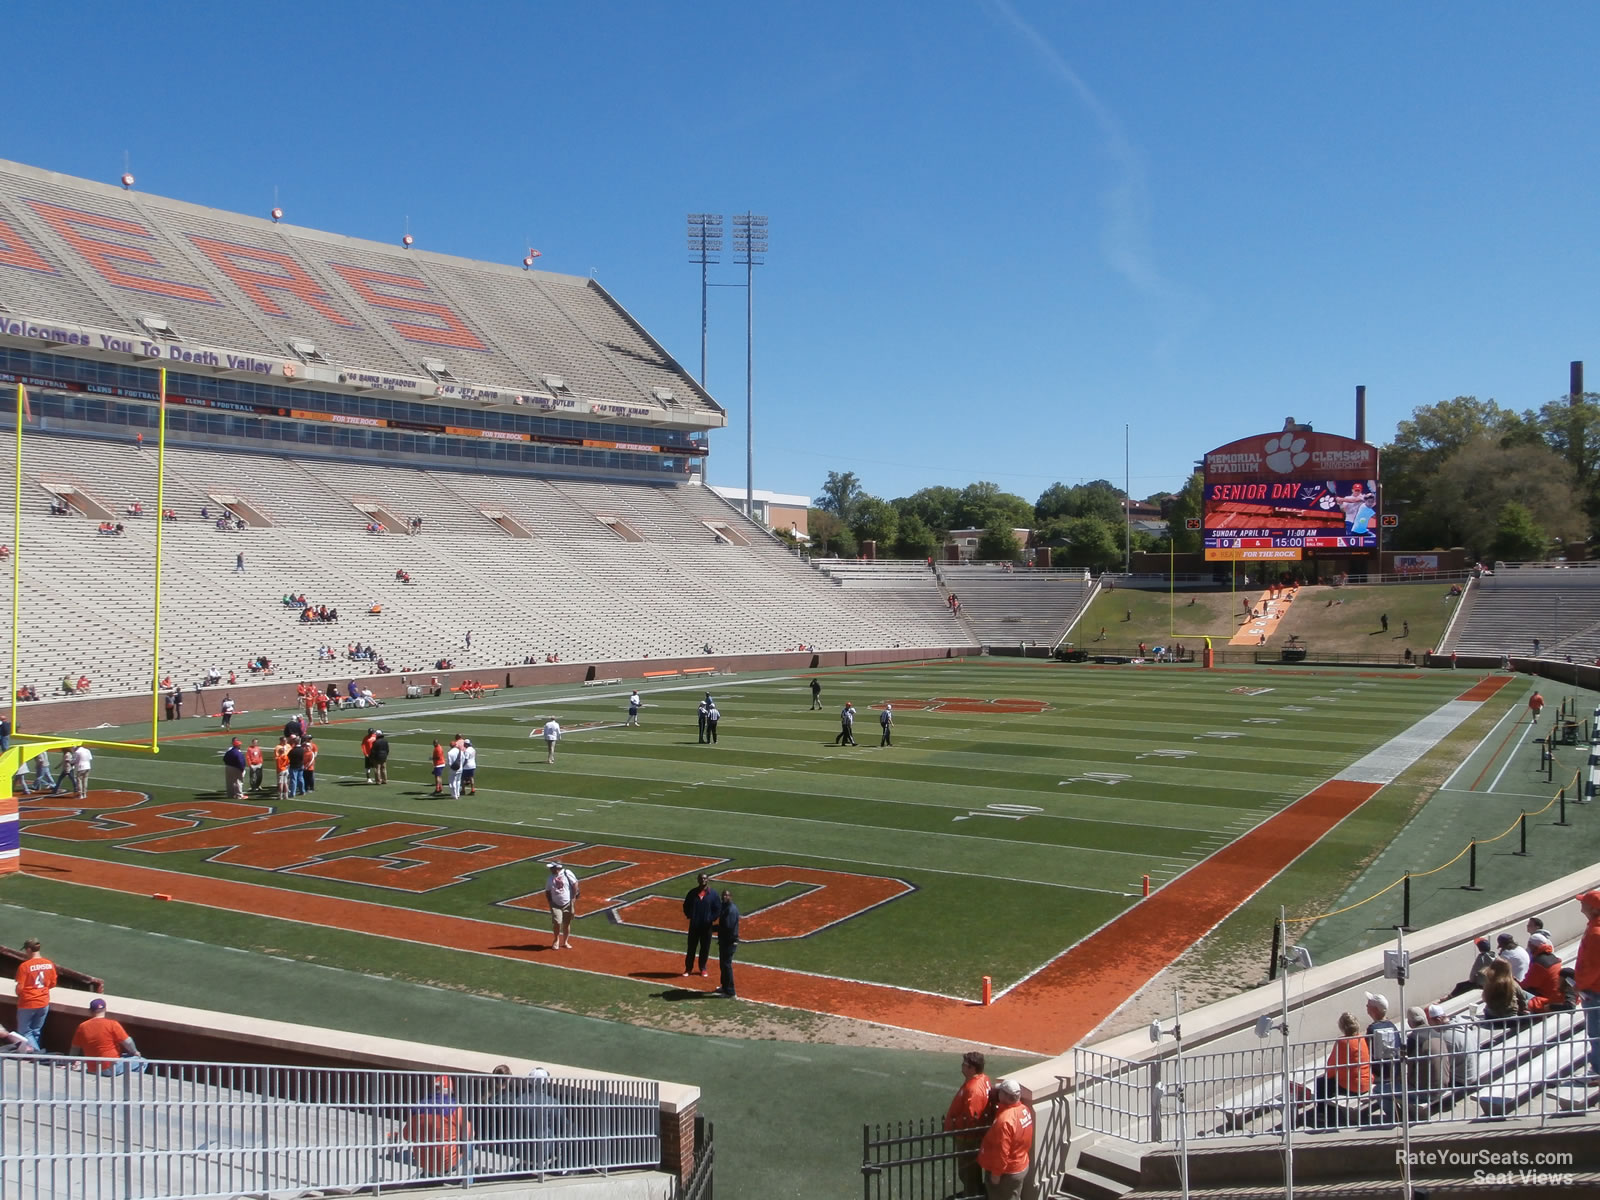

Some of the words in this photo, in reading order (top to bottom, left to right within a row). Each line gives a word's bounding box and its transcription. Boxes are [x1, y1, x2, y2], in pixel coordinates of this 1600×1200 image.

[100, 334, 132, 353] You
[141, 341, 160, 358] To
[170, 346, 219, 367] Death
[226, 354, 272, 375] Valley
[30, 378, 68, 389] FOOTBALL
[124, 389, 160, 401] FOOTBALL
[459, 387, 475, 395] JEFF
[217, 401, 254, 411] FOOTBALL
[332, 415, 346, 423] FOR
[347, 416, 360, 424] THE
[1207, 453, 1262, 463] MEMORIAL
[1210, 464, 1259, 473] STADIUM
[1320, 461, 1363, 470] UNIVERSITY
[1212, 484, 1268, 500] SENIOR
[1271, 483, 1301, 499] DAY
[1187, 520, 1200, 528] 25
[1383, 516, 1396, 525] 25
[1275, 538, 1302, 547] 15:00
[1350, 538, 1356, 546] 0
[969, 803, 1044, 821] 10
[30, 963, 53, 972] CLEMSON
[35, 971, 45, 988] 4
